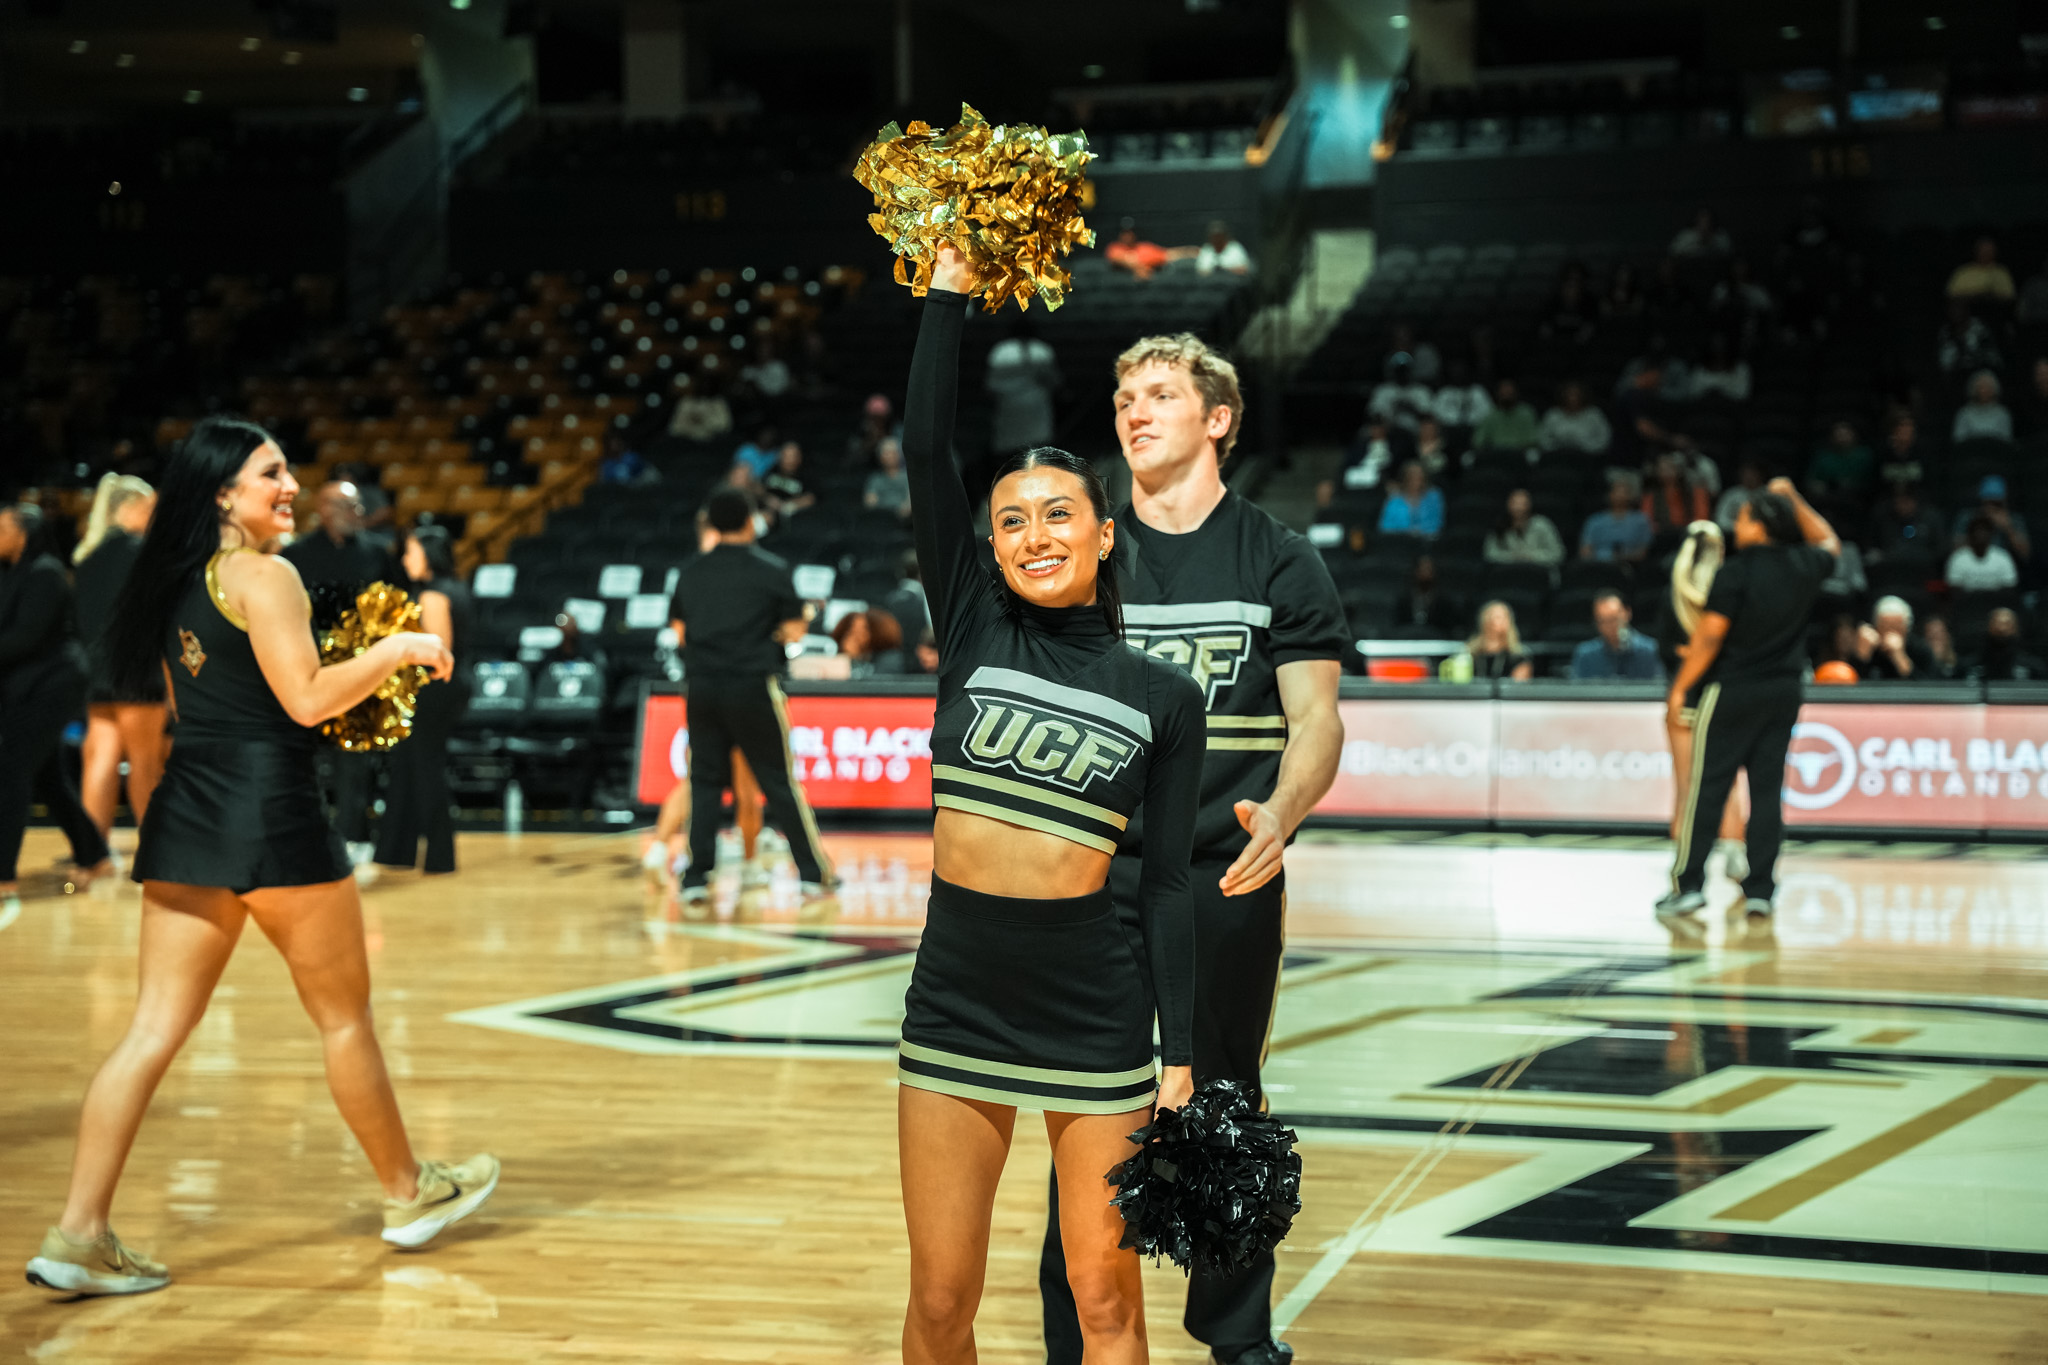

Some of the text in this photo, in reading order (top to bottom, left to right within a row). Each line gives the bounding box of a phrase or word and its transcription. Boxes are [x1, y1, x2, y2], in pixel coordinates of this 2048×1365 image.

[966, 702, 1132, 784] UCF
[1859, 737, 1958, 771] CARL
[791, 757, 911, 783] LANDO
